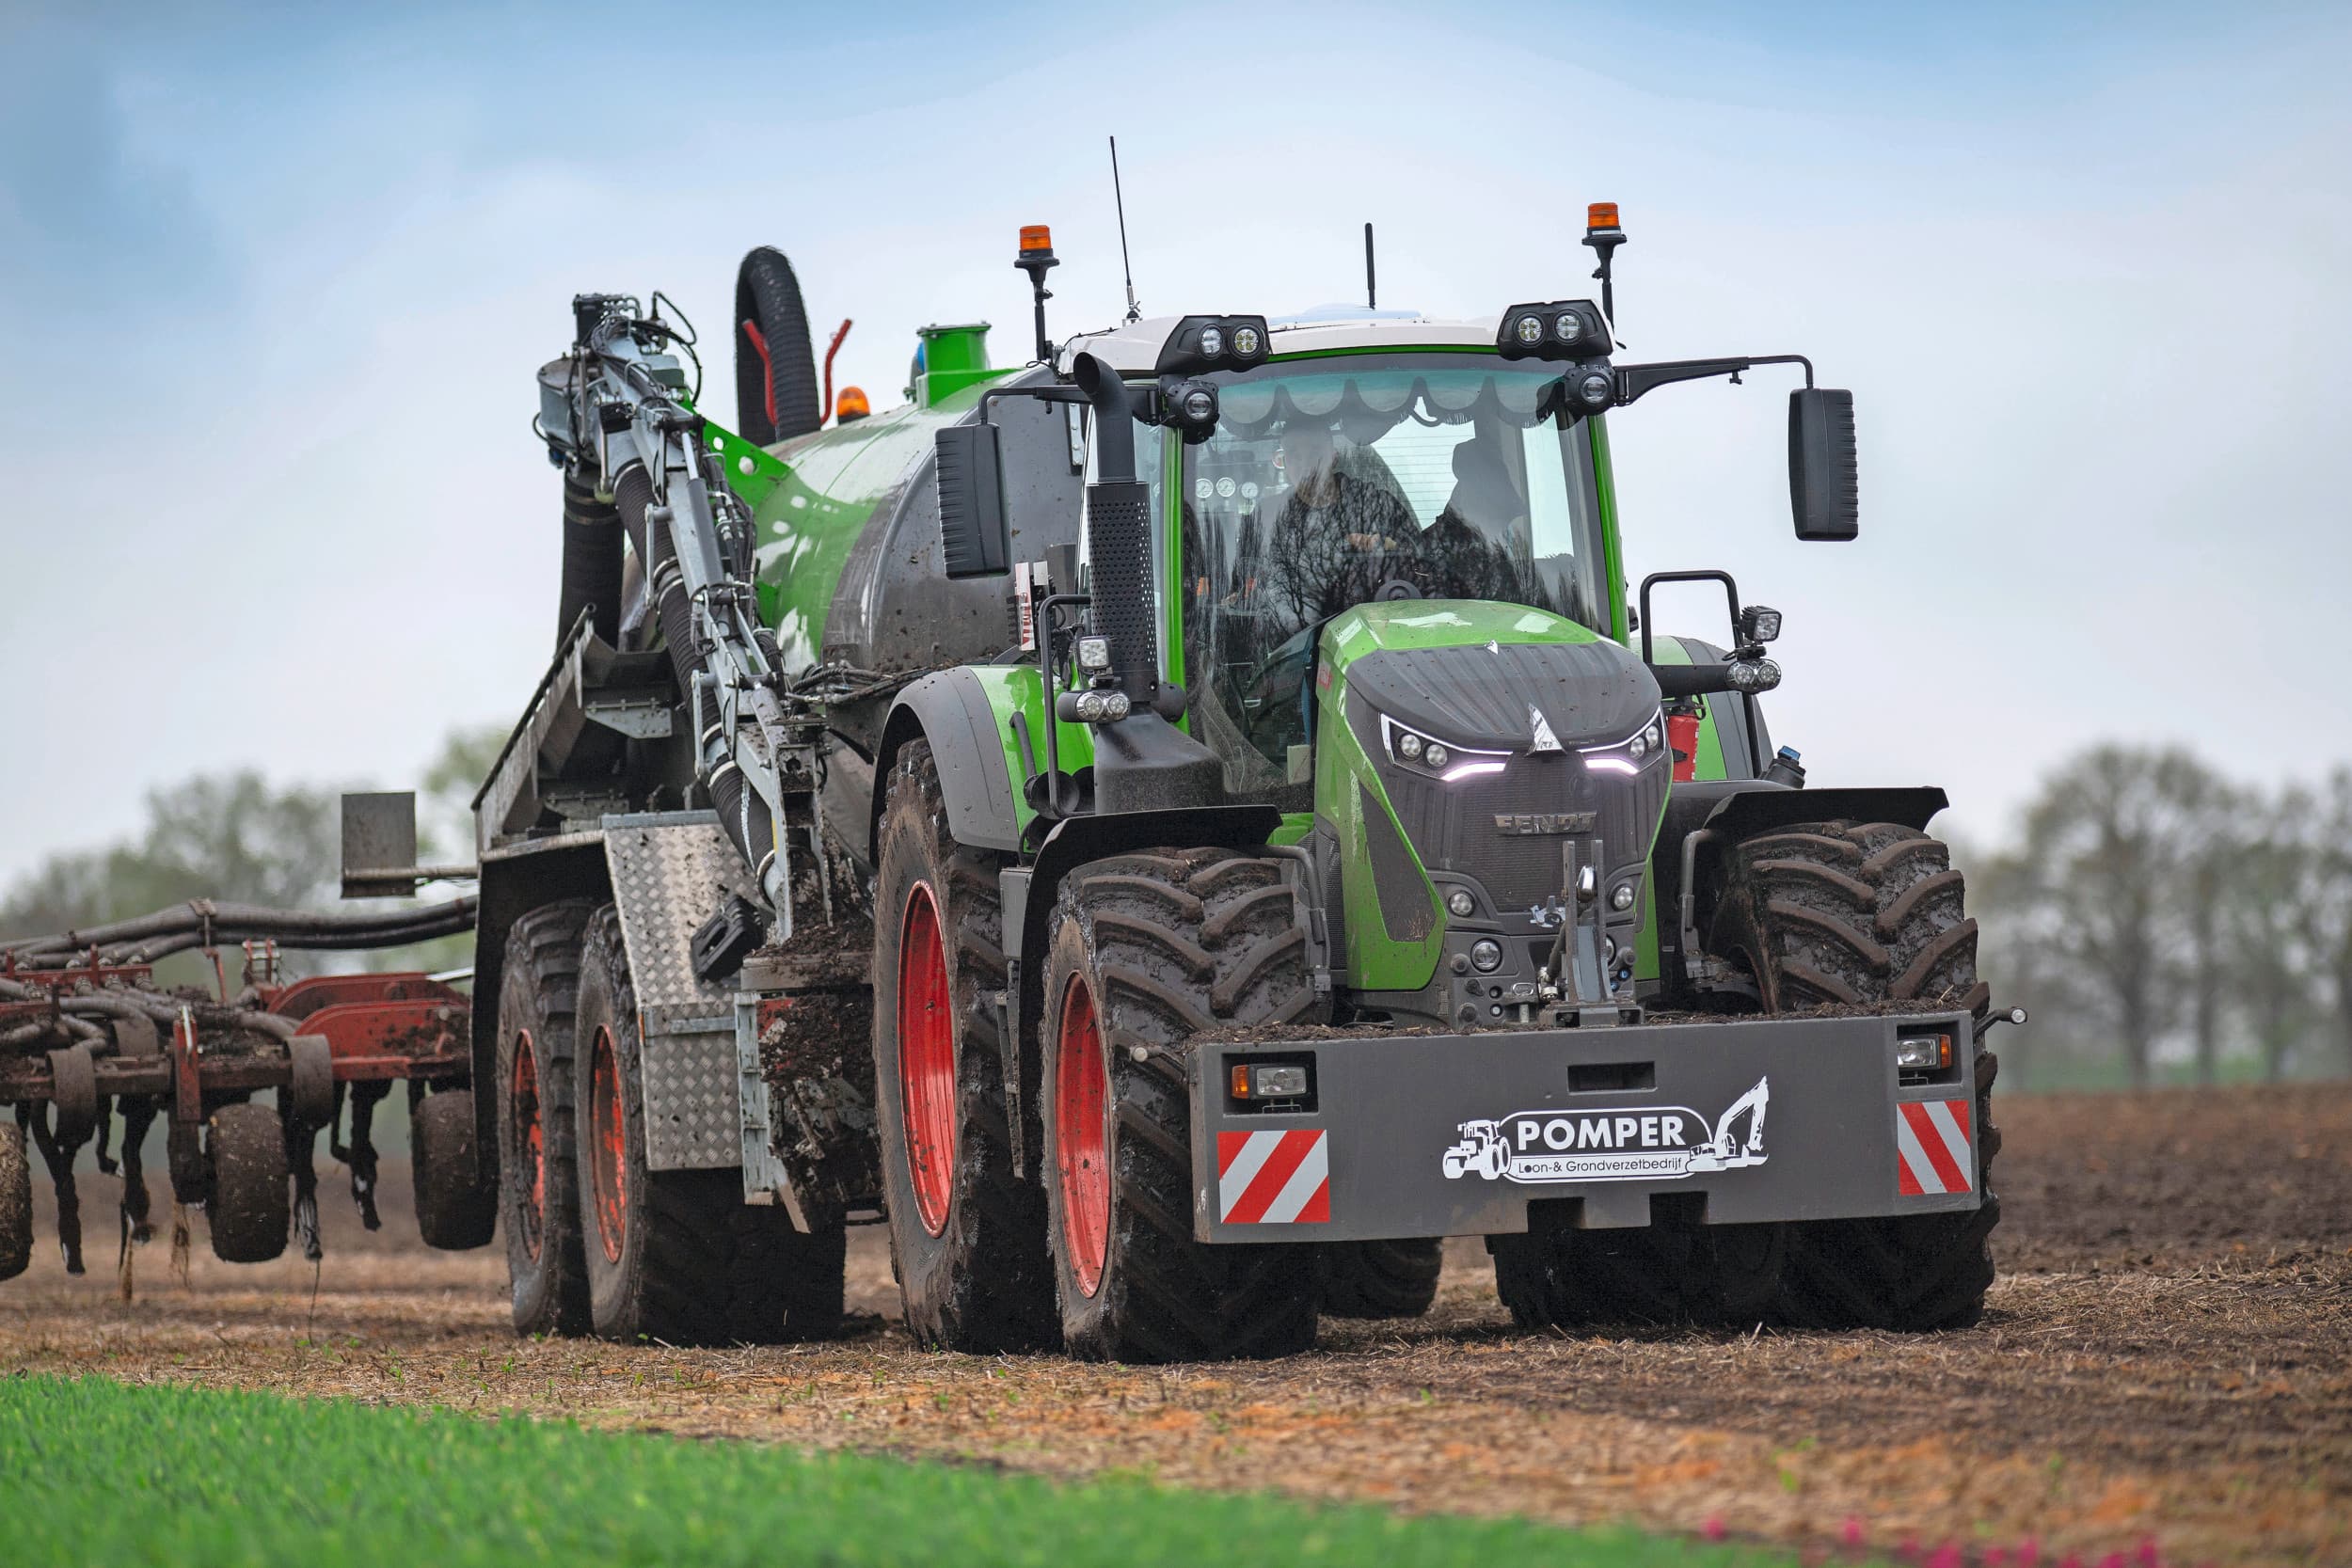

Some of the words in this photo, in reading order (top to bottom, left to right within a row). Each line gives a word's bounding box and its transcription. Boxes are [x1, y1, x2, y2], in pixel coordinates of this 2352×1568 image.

[1494, 812, 1597, 834] FENDT
[1518, 1116, 1686, 1150] POMPER
[1565, 1157, 1682, 1172] Grondverzetbedrijf
